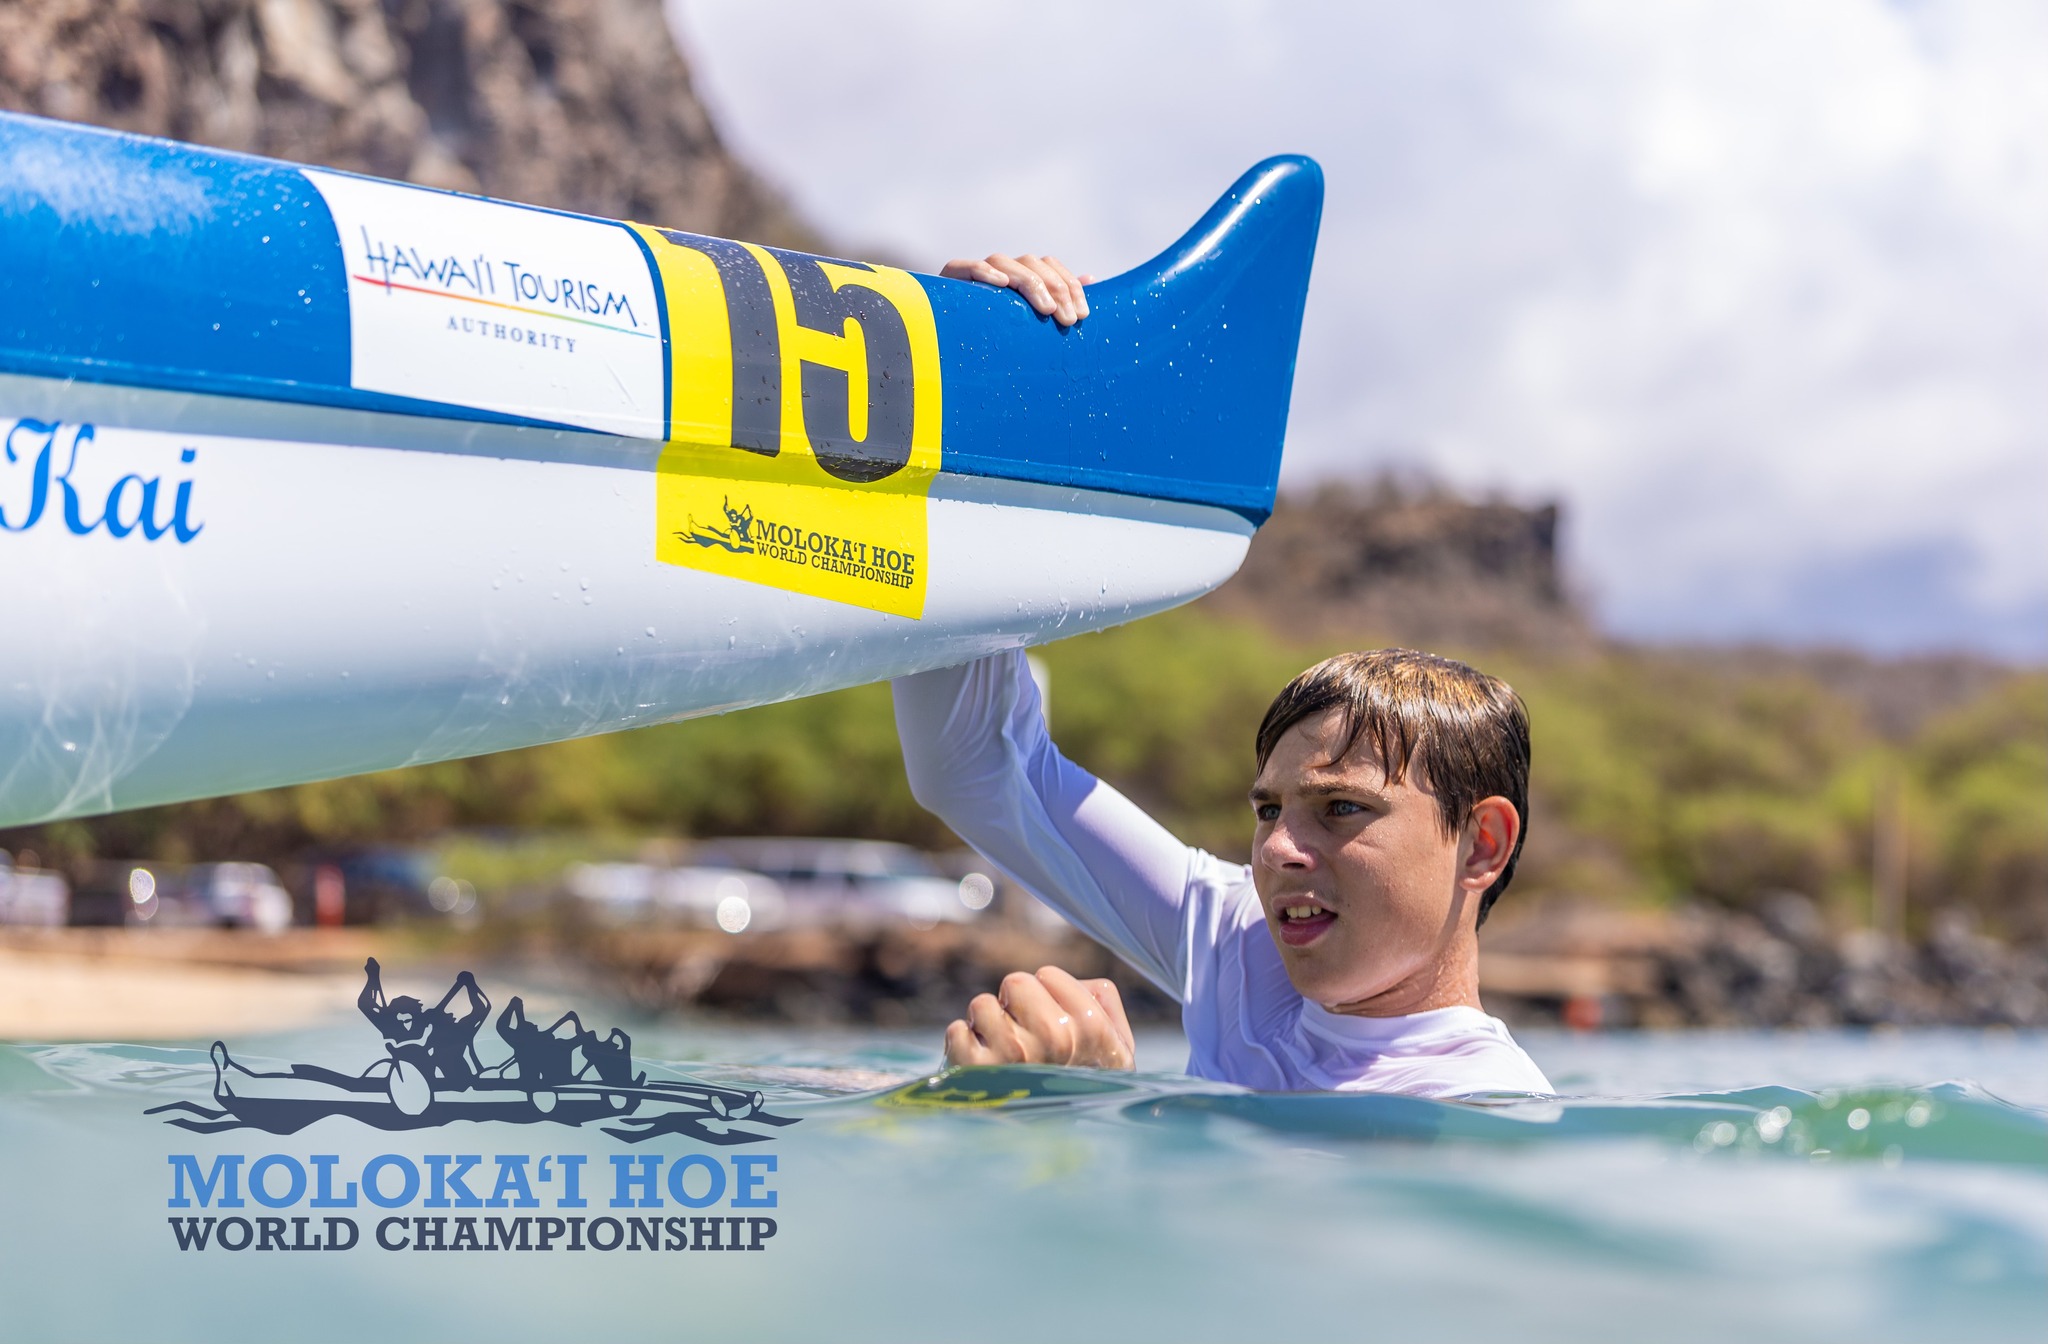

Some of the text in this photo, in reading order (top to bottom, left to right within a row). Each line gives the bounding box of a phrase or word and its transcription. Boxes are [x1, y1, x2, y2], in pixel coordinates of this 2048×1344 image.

[503, 260, 638, 328] TOURISM
[446, 315, 577, 353] AUTHORITY
[656, 228, 915, 483] 15
[0, 416, 206, 544] Kai
[756, 541, 914, 590] WORLD CHAMPIONSHIP
[871, 545, 916, 576] HOE
